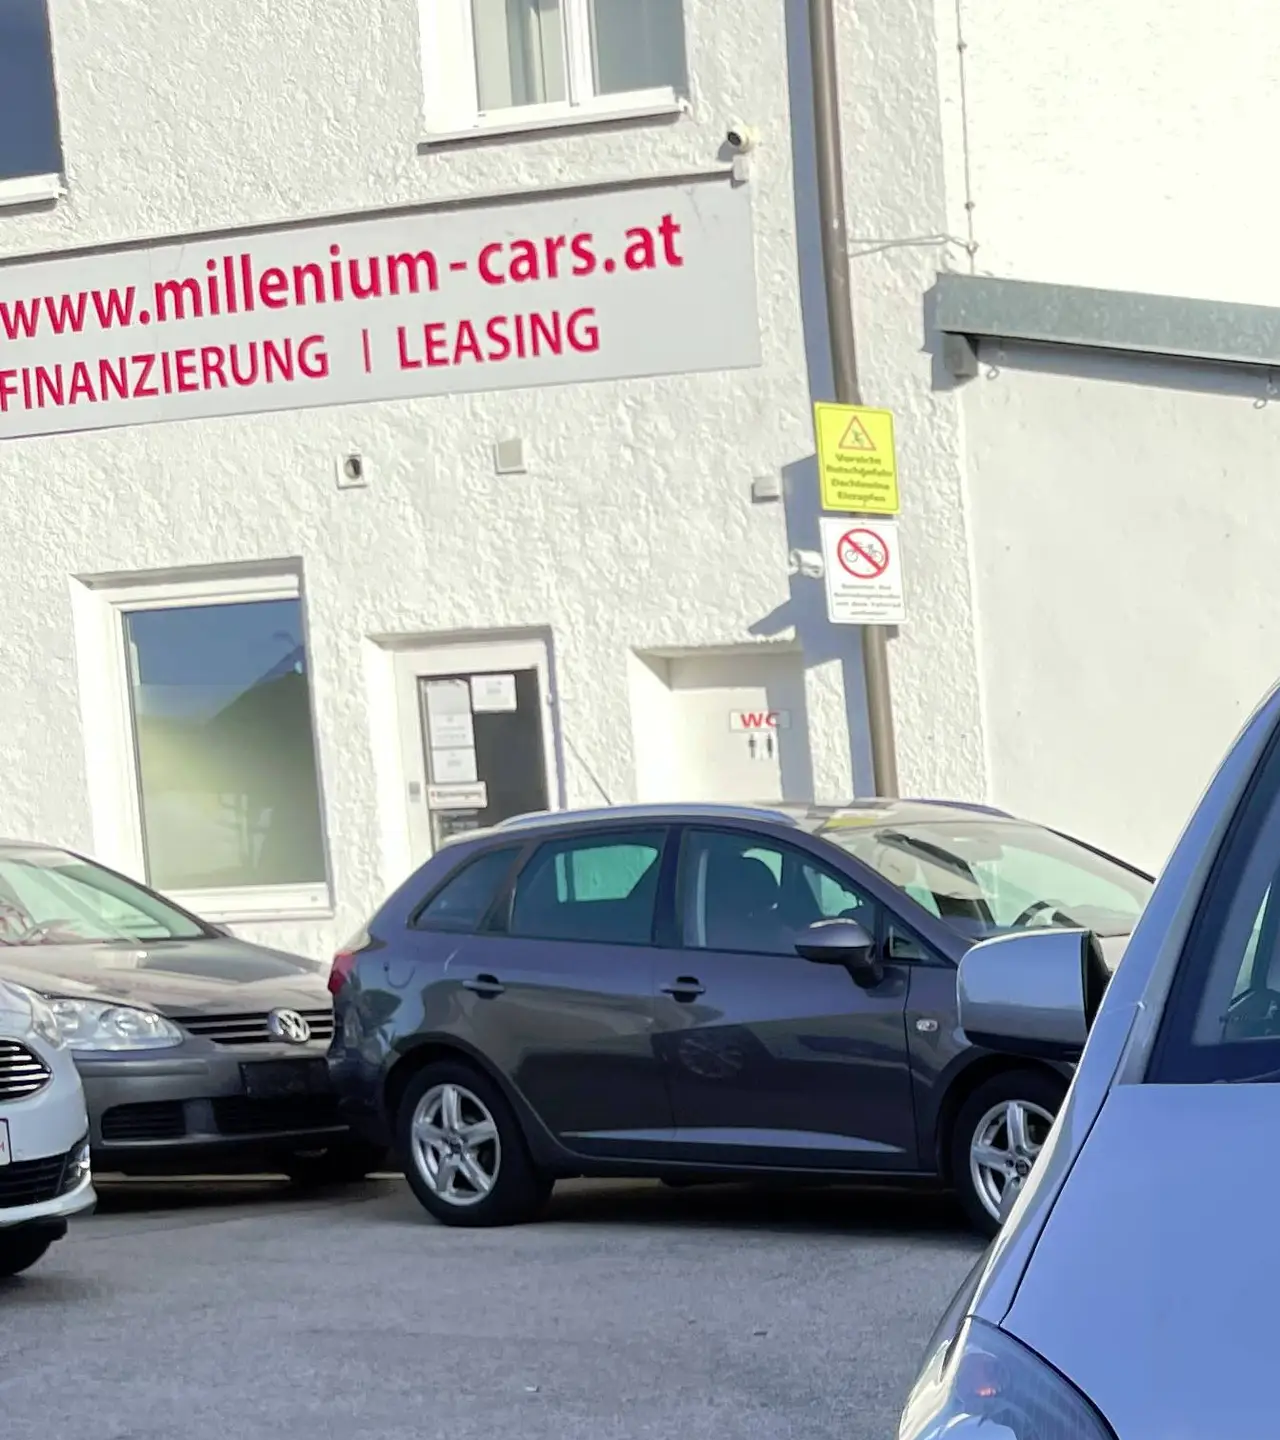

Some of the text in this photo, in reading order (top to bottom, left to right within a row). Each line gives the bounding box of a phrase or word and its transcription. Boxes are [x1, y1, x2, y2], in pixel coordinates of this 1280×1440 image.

[1, 213, 685, 340] www.millenium-cars.at
[0, 307, 602, 412] FINANZIERUNG LEASING
[740, 712, 779, 728] WC
